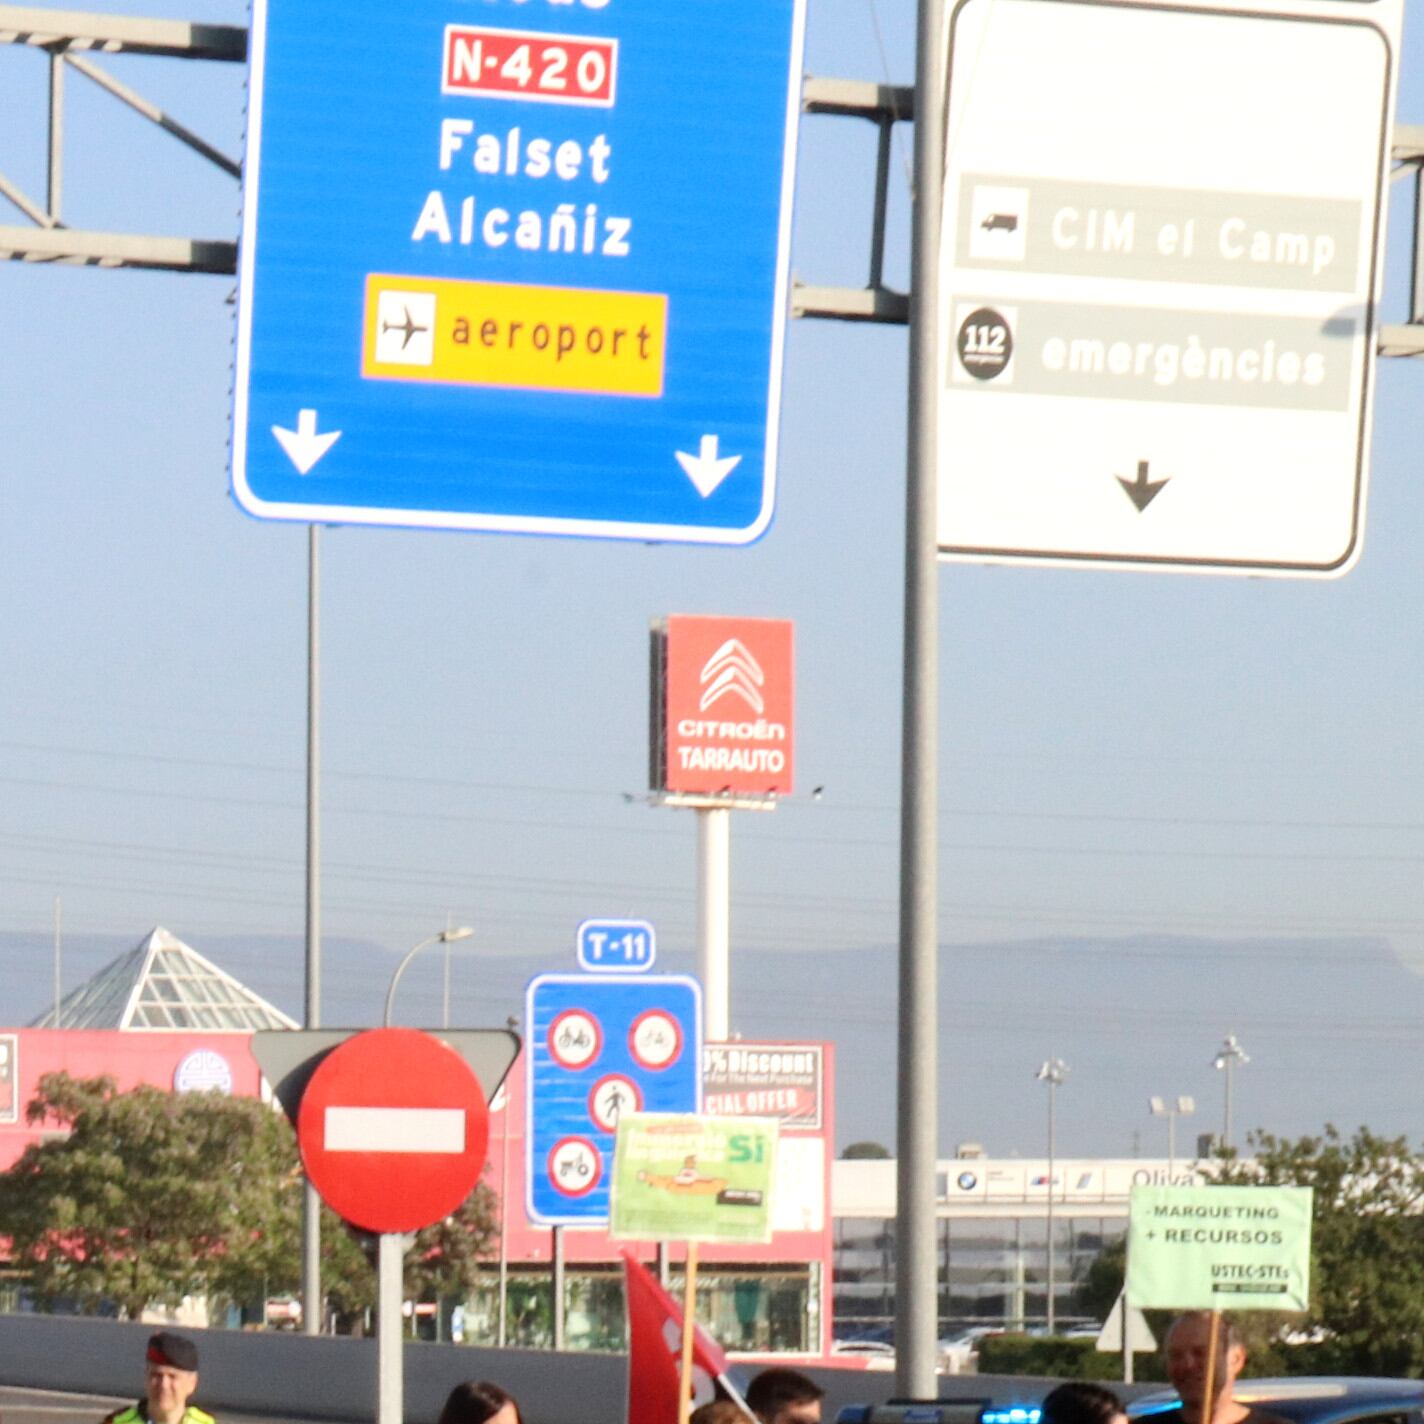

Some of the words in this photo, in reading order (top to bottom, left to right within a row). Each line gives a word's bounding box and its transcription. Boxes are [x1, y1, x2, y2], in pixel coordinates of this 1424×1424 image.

[453, 38, 606, 93] N-420
[439, 118, 611, 183] Falset
[411, 190, 631, 256] Alcañiz
[1052, 206, 1135, 253] CIM
[1158, 219, 1194, 257] el
[1219, 216, 1335, 275] Camp
[452, 316, 650, 361] aeroport
[964, 325, 1006, 353] 112
[1043, 335, 1325, 386] emergències
[678, 747, 784, 773] TARRAUTO
[588, 932, 645, 960] T-11
[746, 1088, 797, 1111] OFFER
[1165, 1228, 1282, 1245] RECURSOS
